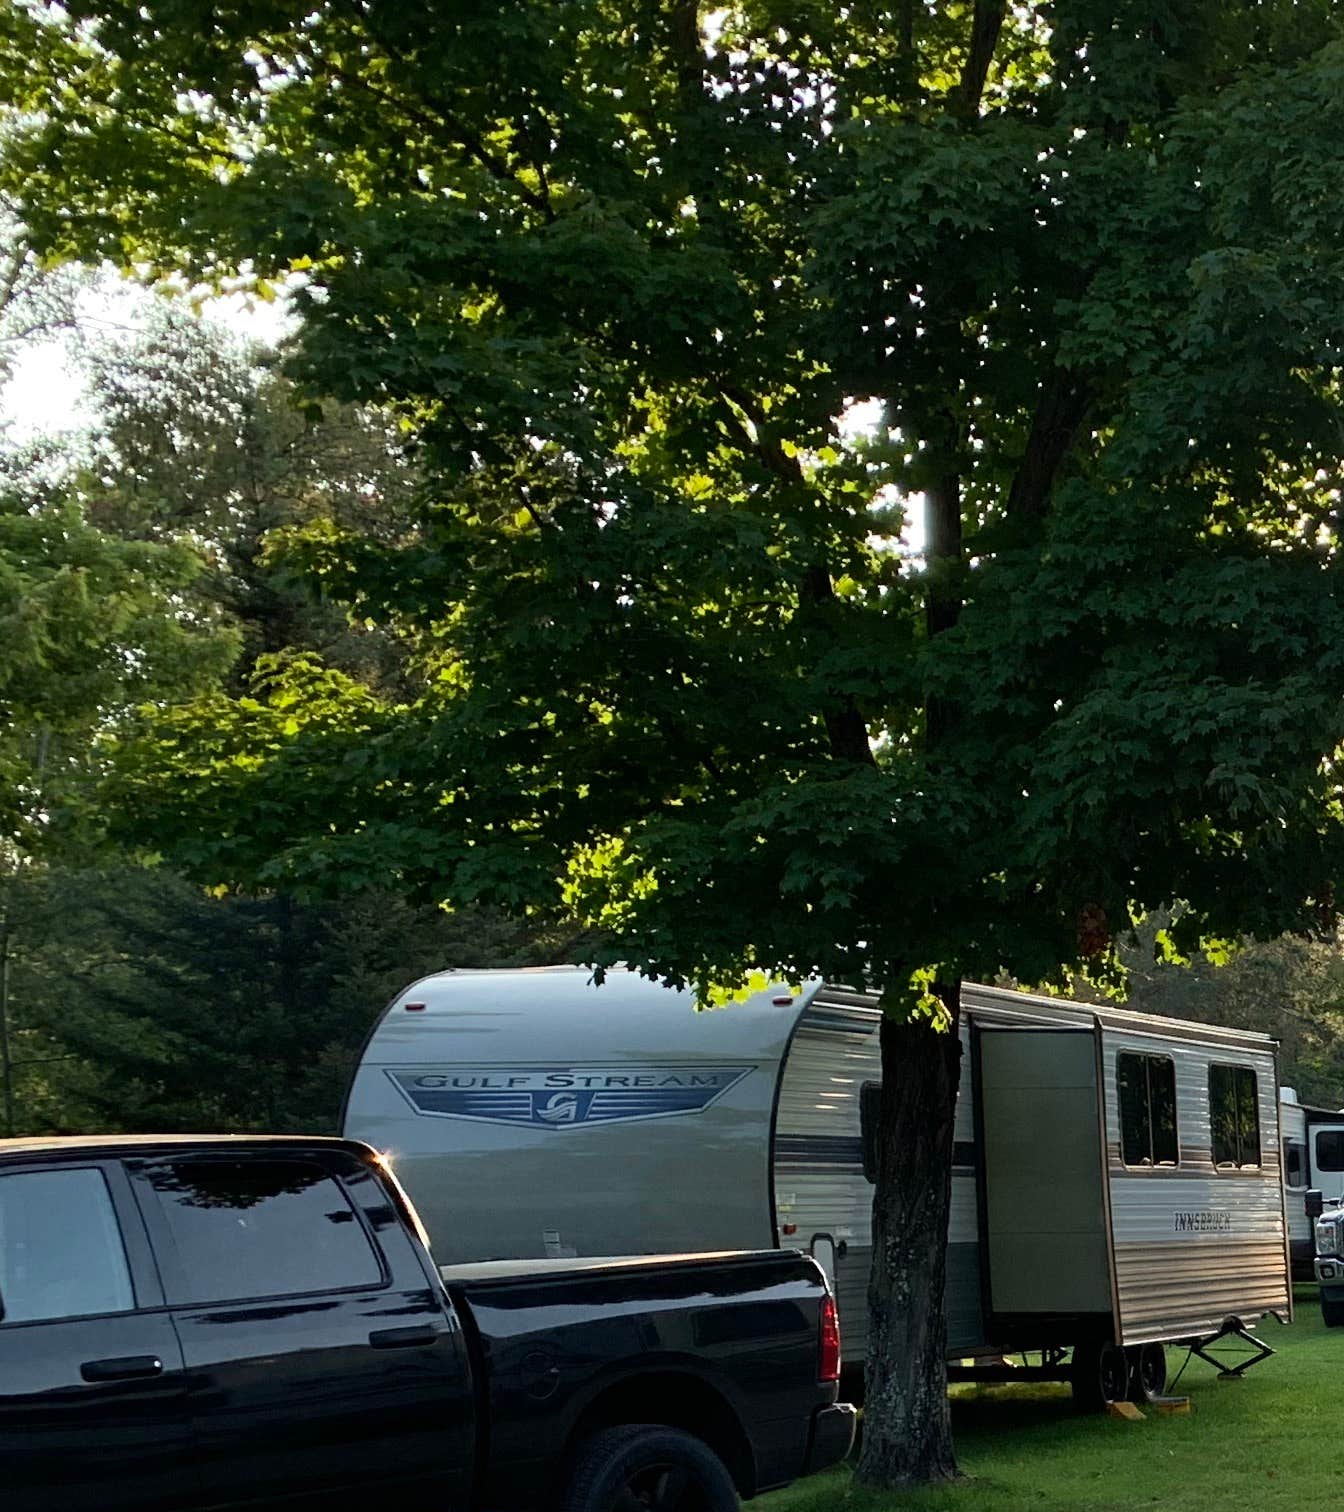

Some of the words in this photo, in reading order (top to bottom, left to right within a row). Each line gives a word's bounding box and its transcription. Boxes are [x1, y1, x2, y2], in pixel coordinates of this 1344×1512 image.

[413, 1074, 531, 1089] GULF
[544, 1073, 718, 1088] STREAM
[1174, 1212, 1231, 1231] INNSBRUCK
